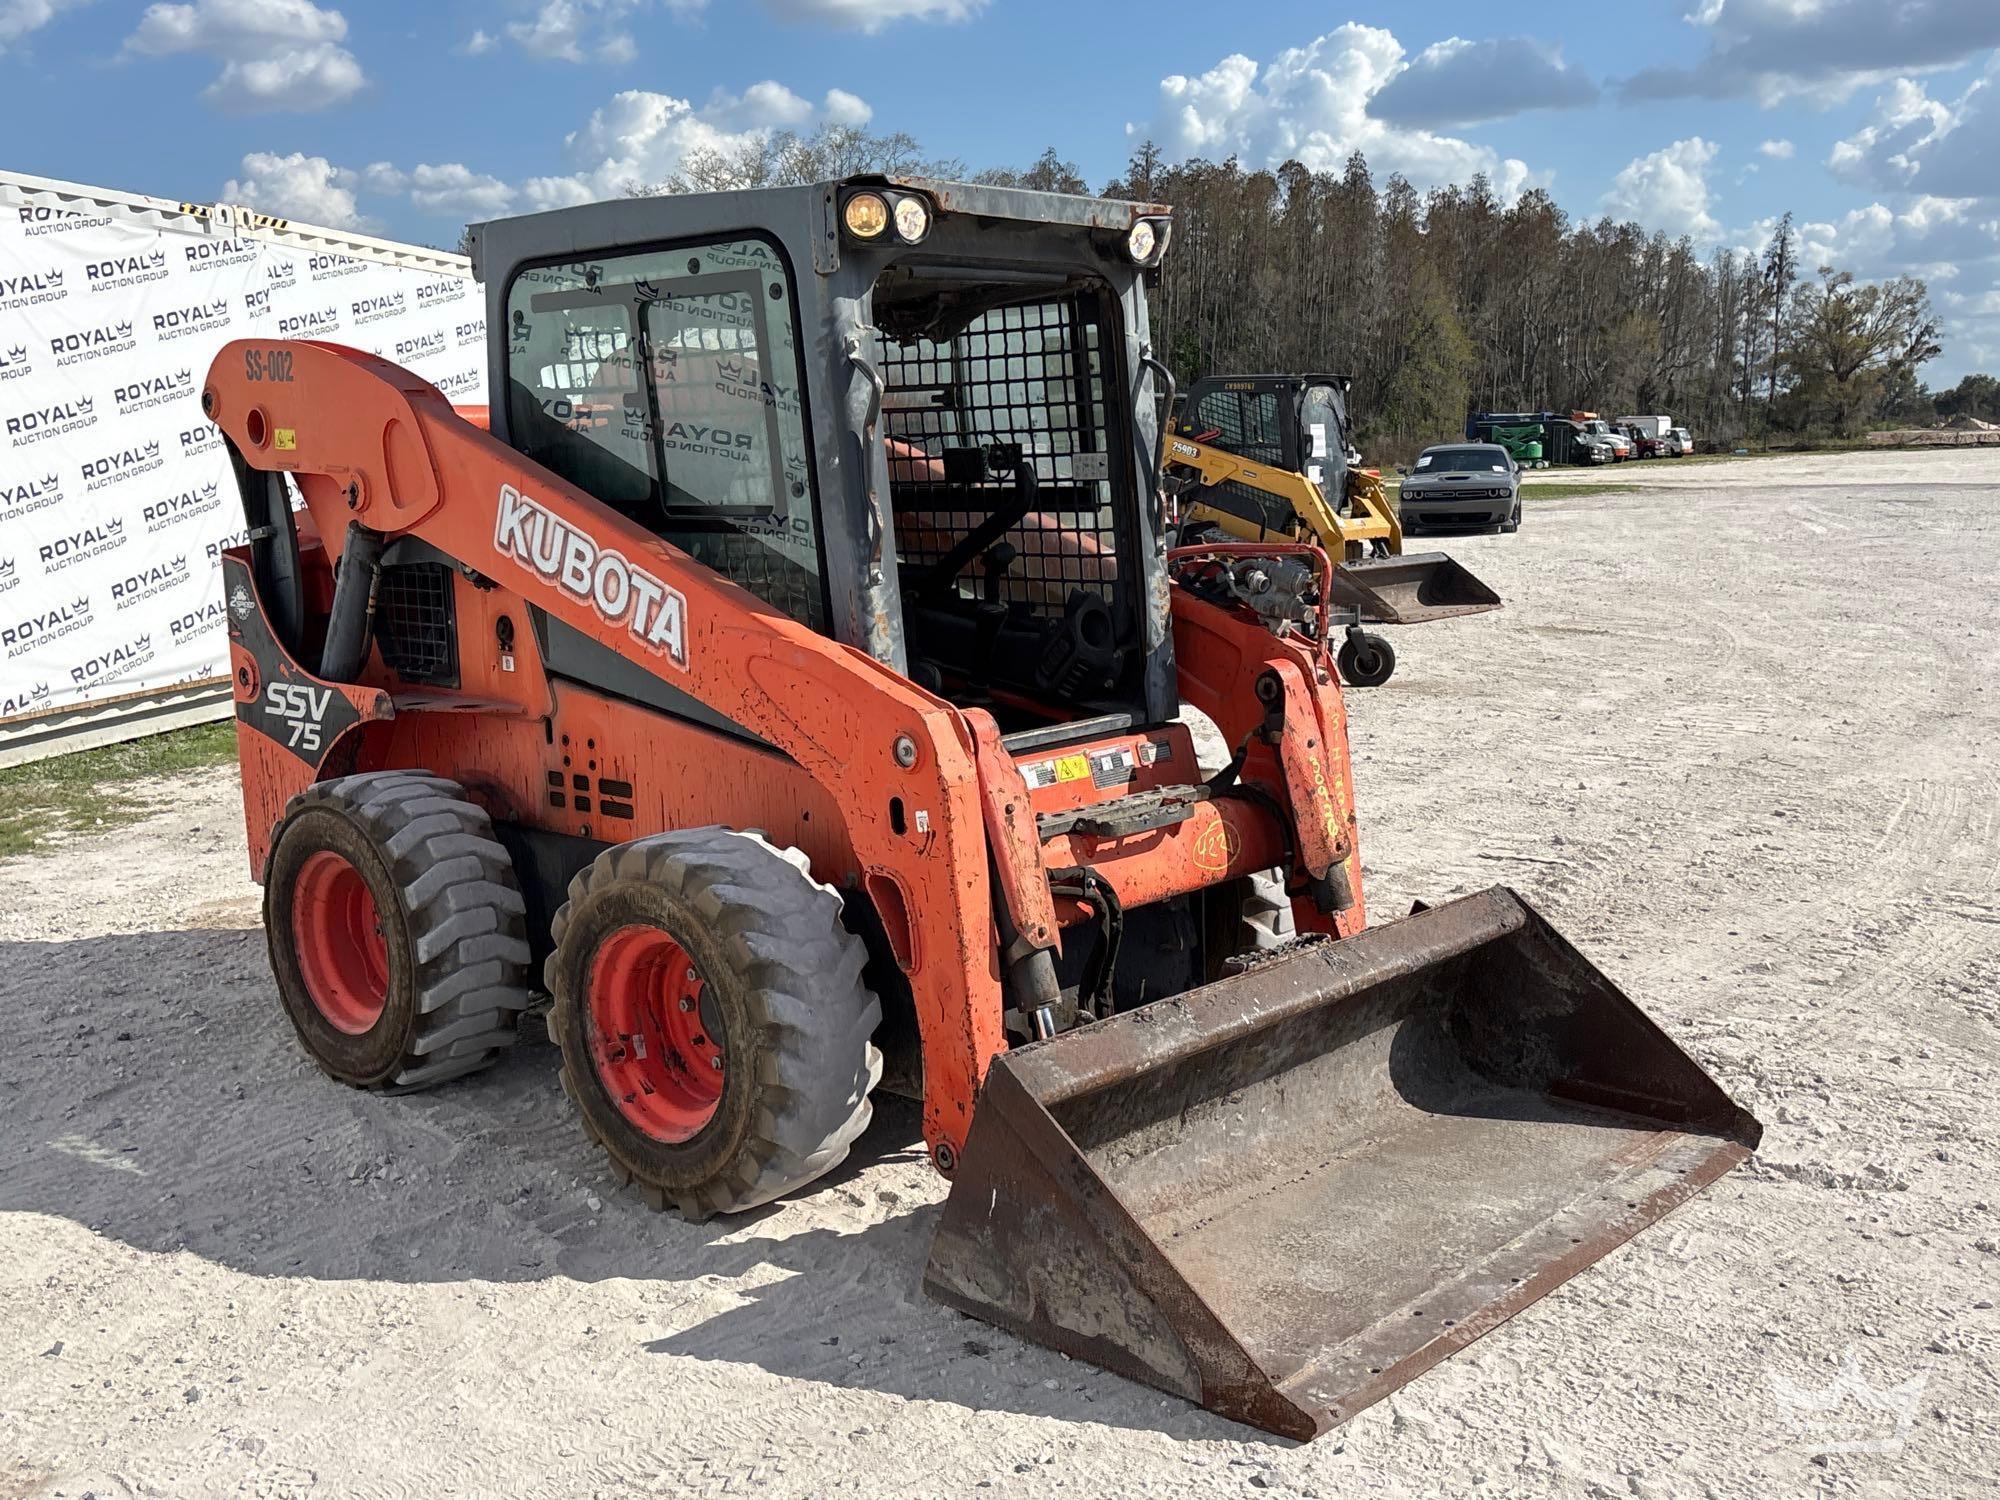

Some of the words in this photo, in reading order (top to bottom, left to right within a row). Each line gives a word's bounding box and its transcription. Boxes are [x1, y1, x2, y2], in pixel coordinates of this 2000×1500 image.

[25, 222, 72, 236] AUCTION
[74, 217, 113, 230] GROUP
[185, 239, 243, 261] ROYAL
[190, 258, 229, 273] AUCTION
[230, 252, 257, 265] GROUP
[86, 255, 151, 280] ROYAL
[312, 268, 343, 281] AUCTION
[344, 264, 368, 275] GROUP
[91, 276, 135, 293] AUCTION
[136, 270, 169, 284] GROUP
[417, 281, 454, 300] ROYAL
[30, 290, 68, 305] GROUP
[352, 295, 394, 315] ROYAL
[419, 297, 445, 309] AUCTION
[446, 292, 466, 303] GROUP
[153, 305, 213, 330] ROYAL
[158, 325, 199, 342] AUCTION
[200, 317, 231, 332] GROUP
[279, 311, 326, 334] ROYAL
[315, 323, 340, 336] GROUP
[355, 313, 384, 325] AUCTION
[385, 307, 406, 317] GROUP
[51, 326, 117, 354] ROYAL
[57, 349, 101, 367] AUCTION
[103, 340, 136, 355] GROUP
[396, 334, 434, 355] ROYAL
[426, 345, 446, 357] GROUP
[458, 335, 483, 347] AUCTION
[245, 349, 294, 382] SS-002
[114, 375, 176, 403] ROYAL
[119, 396, 161, 416] AUCTION
[162, 387, 195, 403] GROUP
[460, 382, 481, 394] GROUP
[6, 403, 77, 435] ROYAL
[12, 427, 60, 447] AUCTION
[62, 416, 98, 433] GROUP
[1172, 441, 1198, 458] 259D3
[81, 448, 145, 480] ROYAL
[87, 470, 130, 492] AUCTION
[131, 459, 164, 477] GROUP
[26, 493, 64, 513] GROUP
[143, 490, 203, 522] ROYAL
[148, 512, 188, 534] AUCTION
[189, 499, 221, 517] GROUP
[39, 526, 108, 562] ROYAL
[45, 550, 91, 575] AUCTION
[92, 536, 127, 556] GROUP
[111, 564, 172, 600] ROYAL
[497, 489, 686, 664] KUBOTA
[117, 587, 158, 611] AUCTION
[158, 572, 191, 595] GROUP
[2, 606, 73, 647] ROYAL
[170, 600, 227, 636] ROYAL
[8, 632, 56, 659] AUCTION
[57, 615, 94, 637] GROUP
[175, 622, 214, 647] AUCTION
[71, 644, 136, 684] ROYAL
[76, 669, 122, 694] AUCTION
[122, 651, 155, 673] GROUP
[265, 682, 332, 722] SSV
[287, 720, 322, 751] 75
